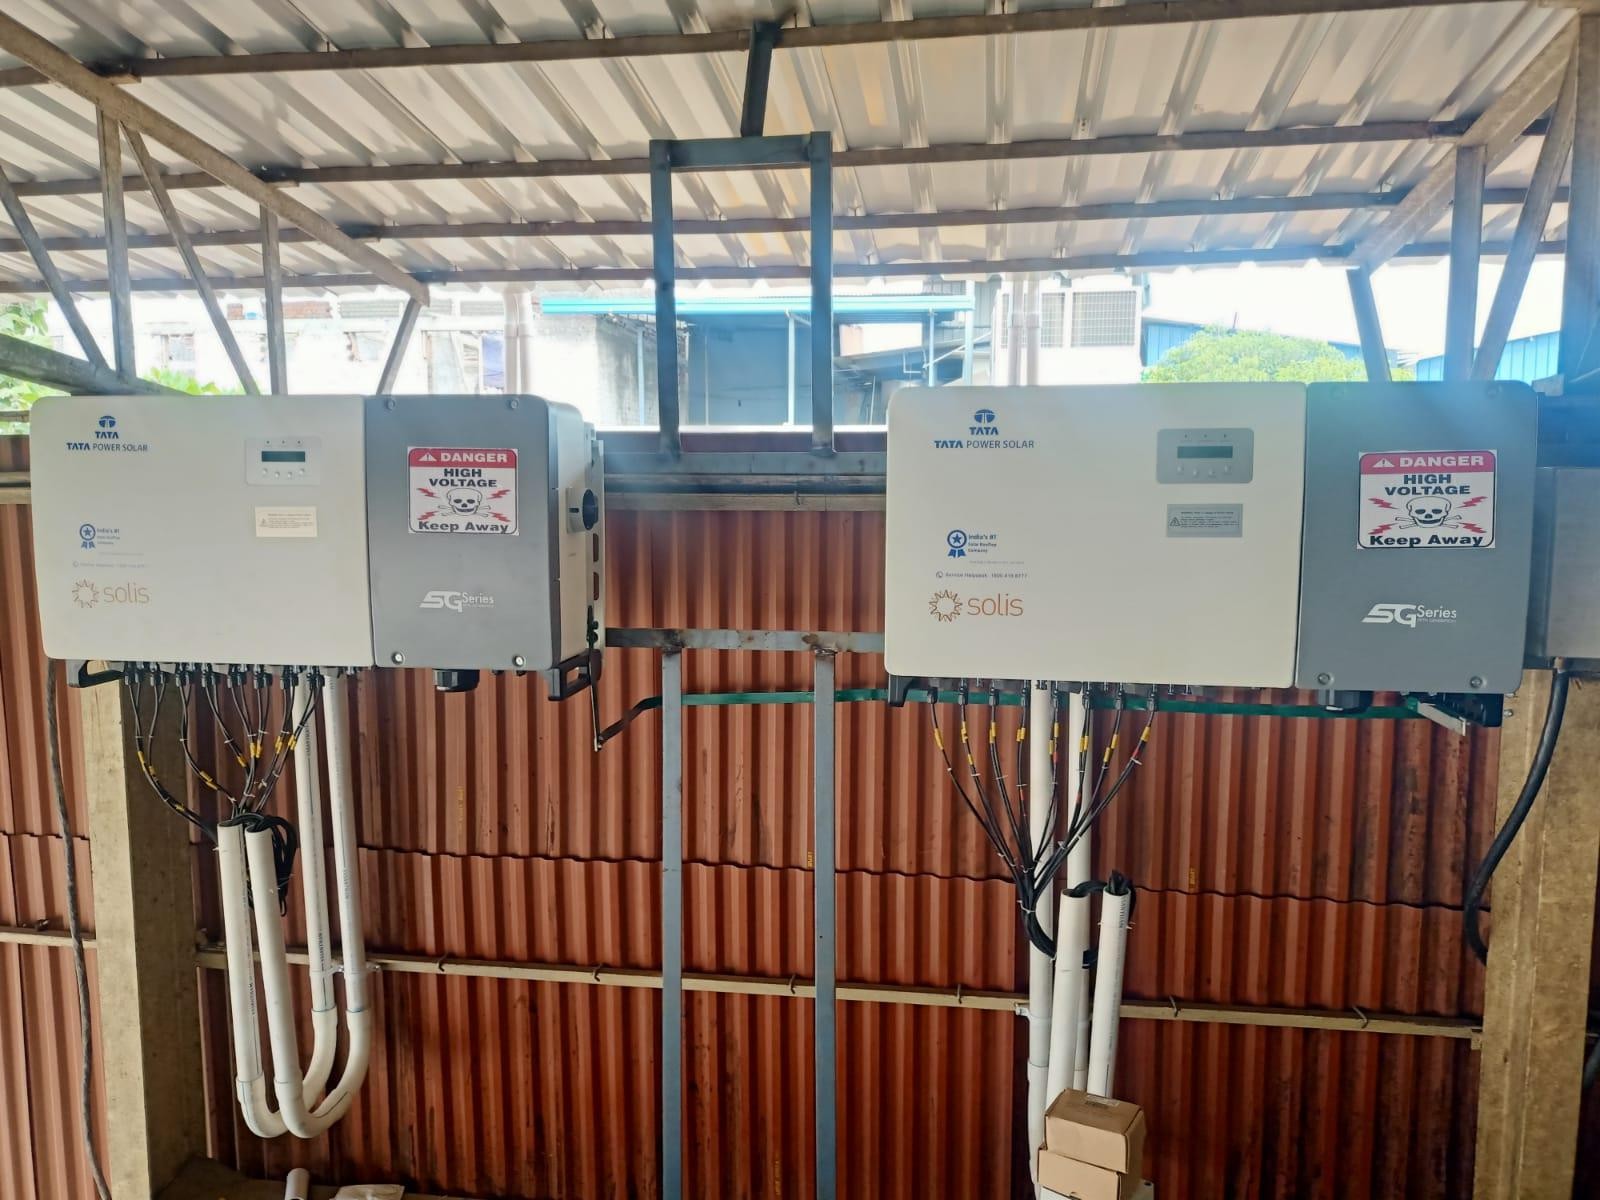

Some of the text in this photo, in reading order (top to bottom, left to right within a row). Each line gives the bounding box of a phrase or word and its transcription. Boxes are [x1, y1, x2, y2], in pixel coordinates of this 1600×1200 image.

[95, 431, 119, 439] TATA
[969, 426, 999, 436] TATA
[66, 442, 149, 452] TATA POWER SOLAR
[934, 440, 1035, 449] TATA POWER SOLAR
[440, 452, 508, 463] DANGER
[1399, 455, 1484, 468] DANGER
[443, 468, 482, 478] HIGH
[429, 478, 498, 488] VOLTAGE
[1403, 474, 1452, 485] HIGH
[1384, 485, 1471, 496] VOLTAGE
[418, 521, 509, 534] Keep Away
[1369, 534, 1484, 548] Keep Away
[103, 581, 150, 604] solis
[462, 592, 495, 604] Series
[967, 593, 1024, 617] solis
[1416, 604, 1457, 619] Series
